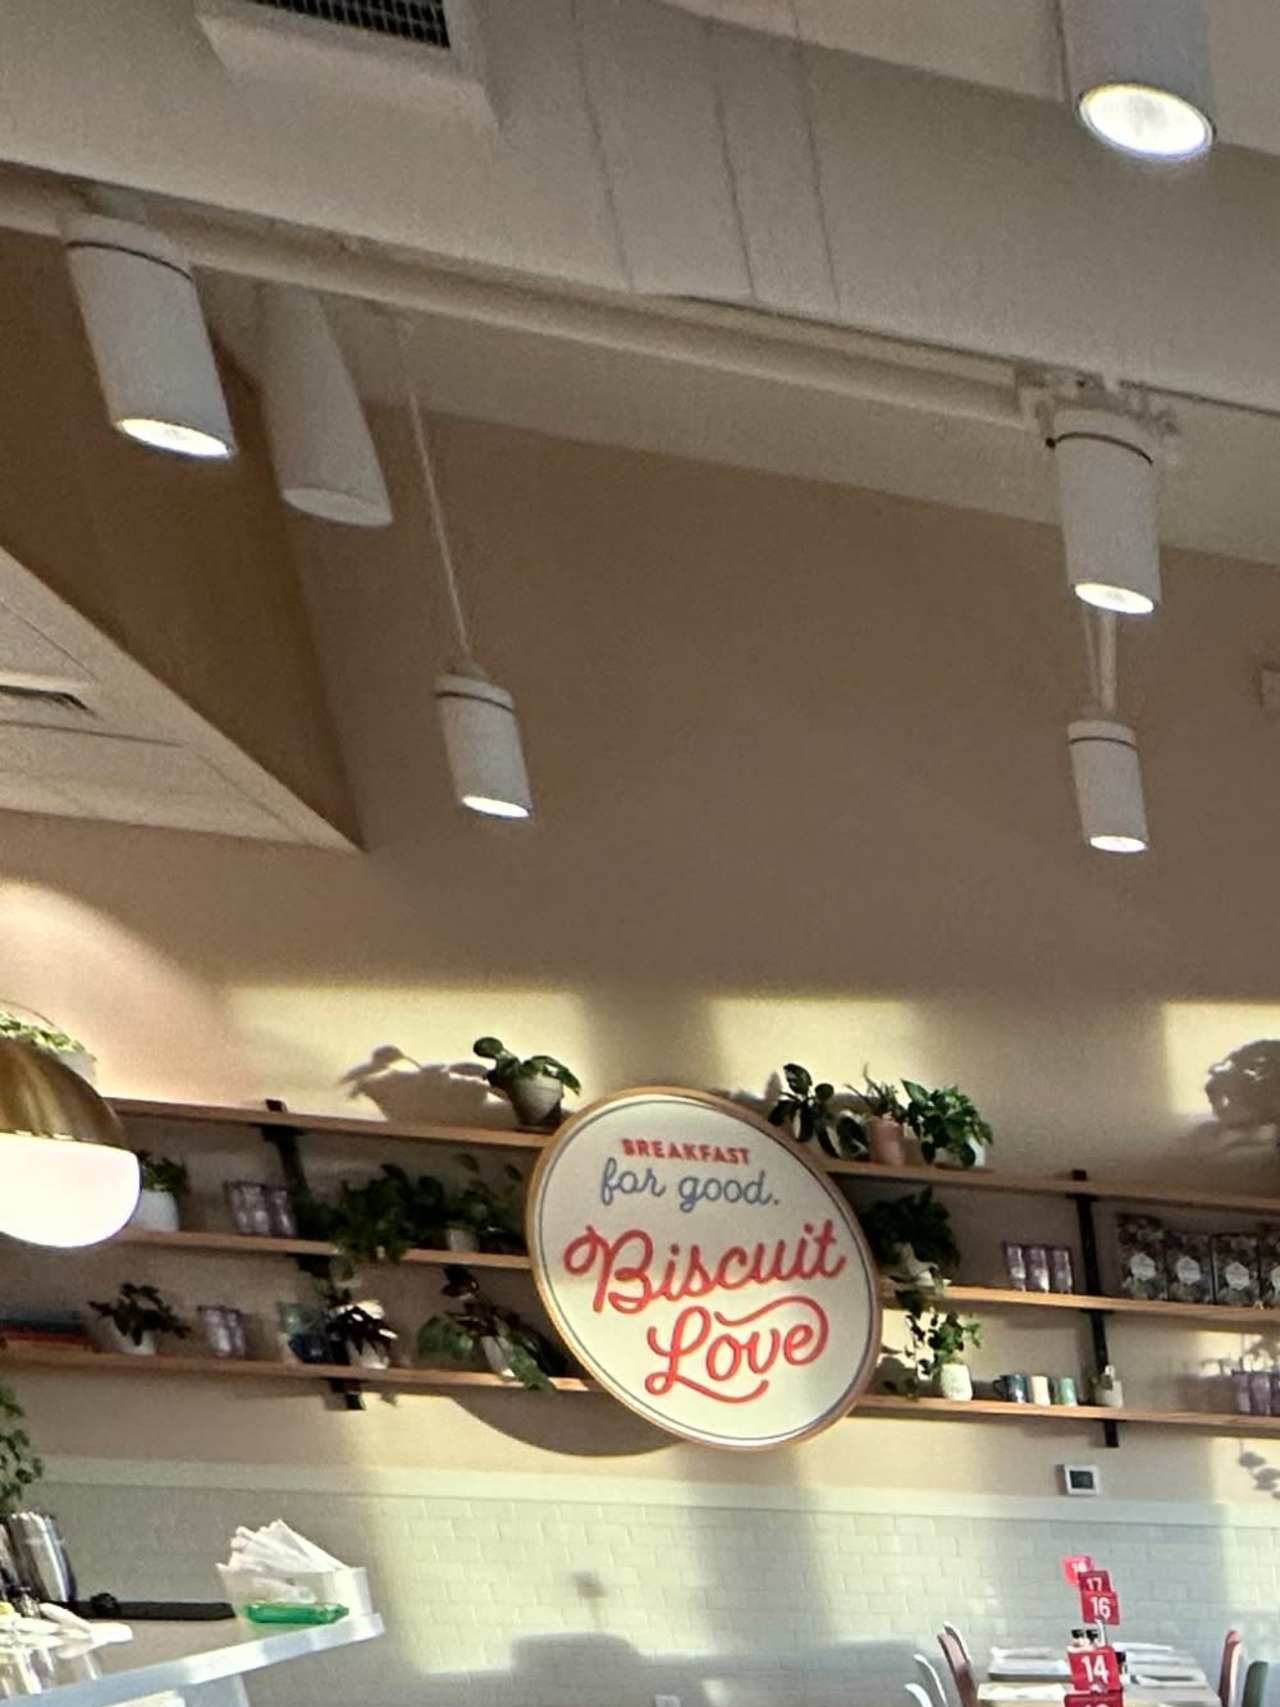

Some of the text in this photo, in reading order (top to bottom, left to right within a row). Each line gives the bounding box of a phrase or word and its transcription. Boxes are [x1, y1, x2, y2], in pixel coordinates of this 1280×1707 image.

[621, 1138, 750, 1165] BREAKFAST
[601, 1157, 780, 1213] for good.
[562, 1218, 847, 1315] Biscuit
[643, 1295, 829, 1404] Love
[1086, 1576, 1103, 1592] 17
[1090, 1596, 1111, 1620] 16
[1081, 1654, 1109, 1685] 14
